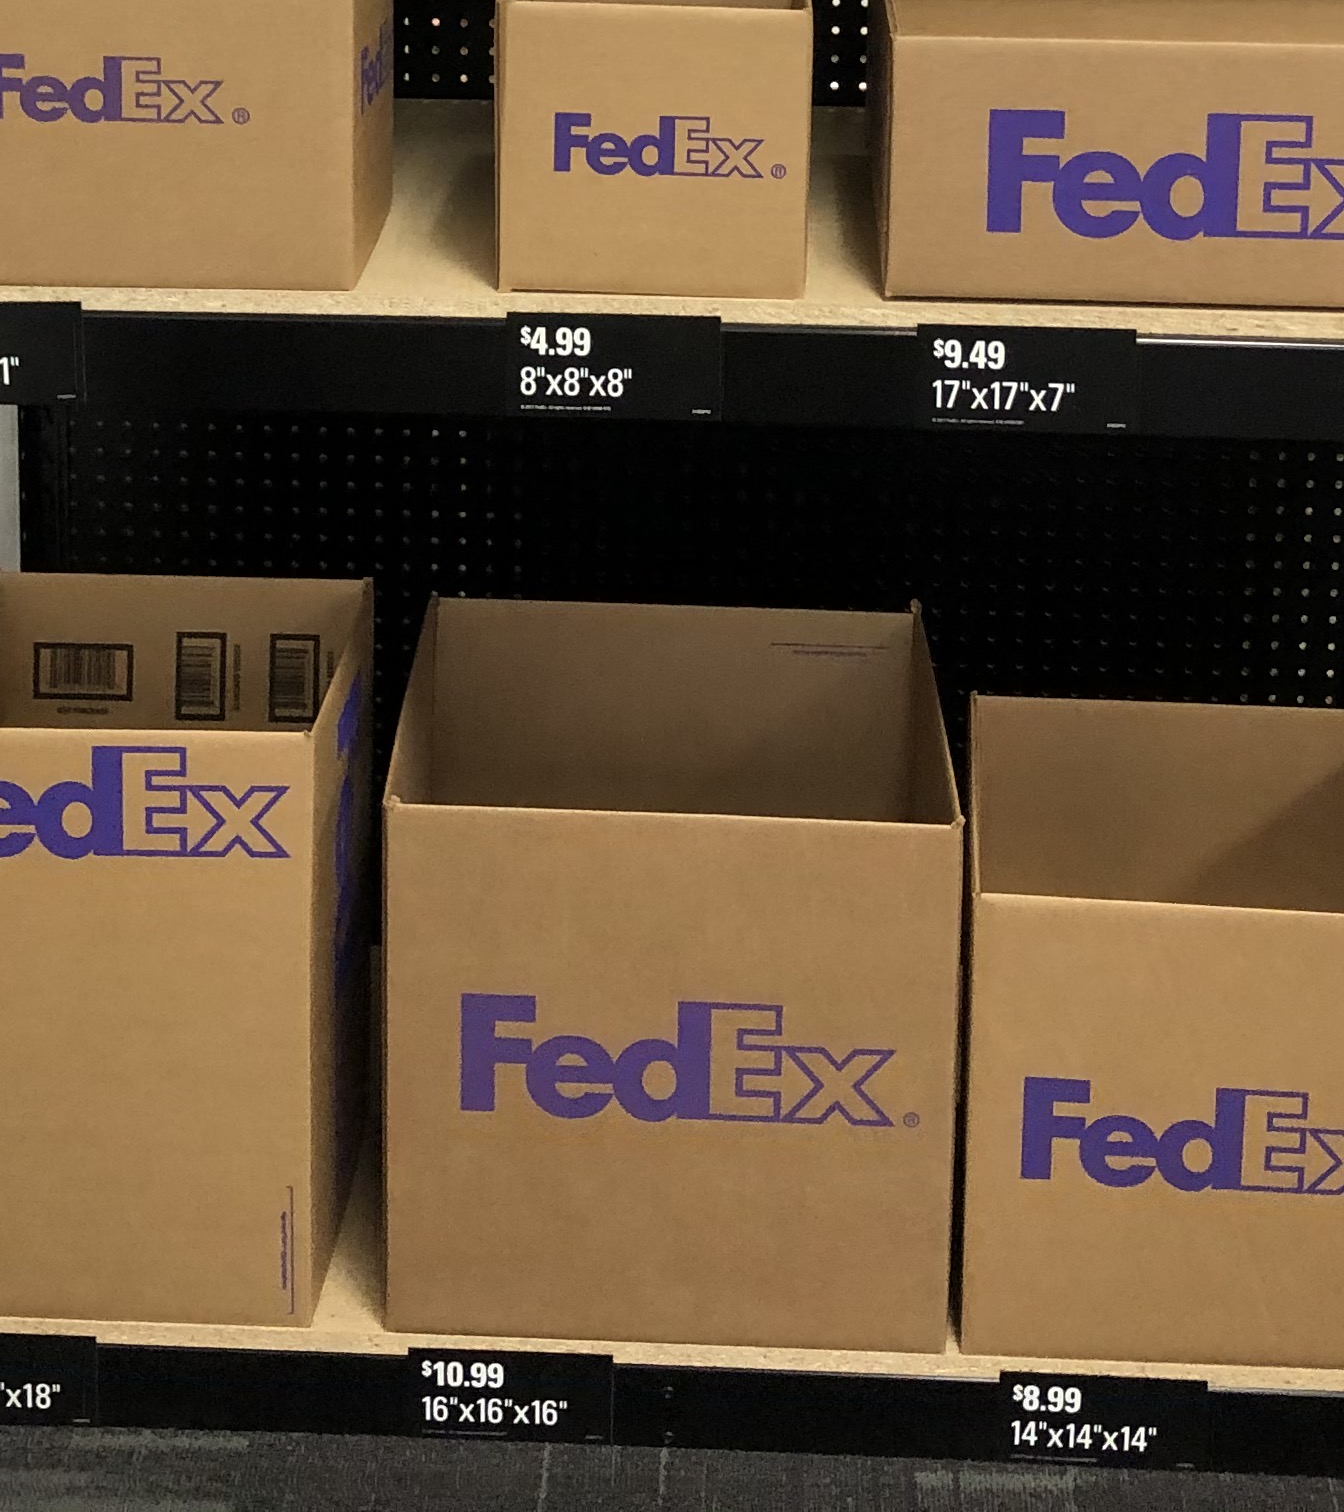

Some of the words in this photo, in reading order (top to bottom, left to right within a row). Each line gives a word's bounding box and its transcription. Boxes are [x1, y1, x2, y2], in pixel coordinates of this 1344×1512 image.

[520, 325, 591, 357] $4.99
[932, 338, 1006, 370] $9.49
[520, 366, 633, 398] 8"x8"x8"
[932, 379, 1075, 412] 17"x17"x7"
[421, 1359, 505, 1388] $10.99
[421, 1395, 568, 1426] 16"x16"x16"
[1012, 1384, 1082, 1413] $8.99
[1011, 1419, 1158, 1452] 14"x14"x14"
